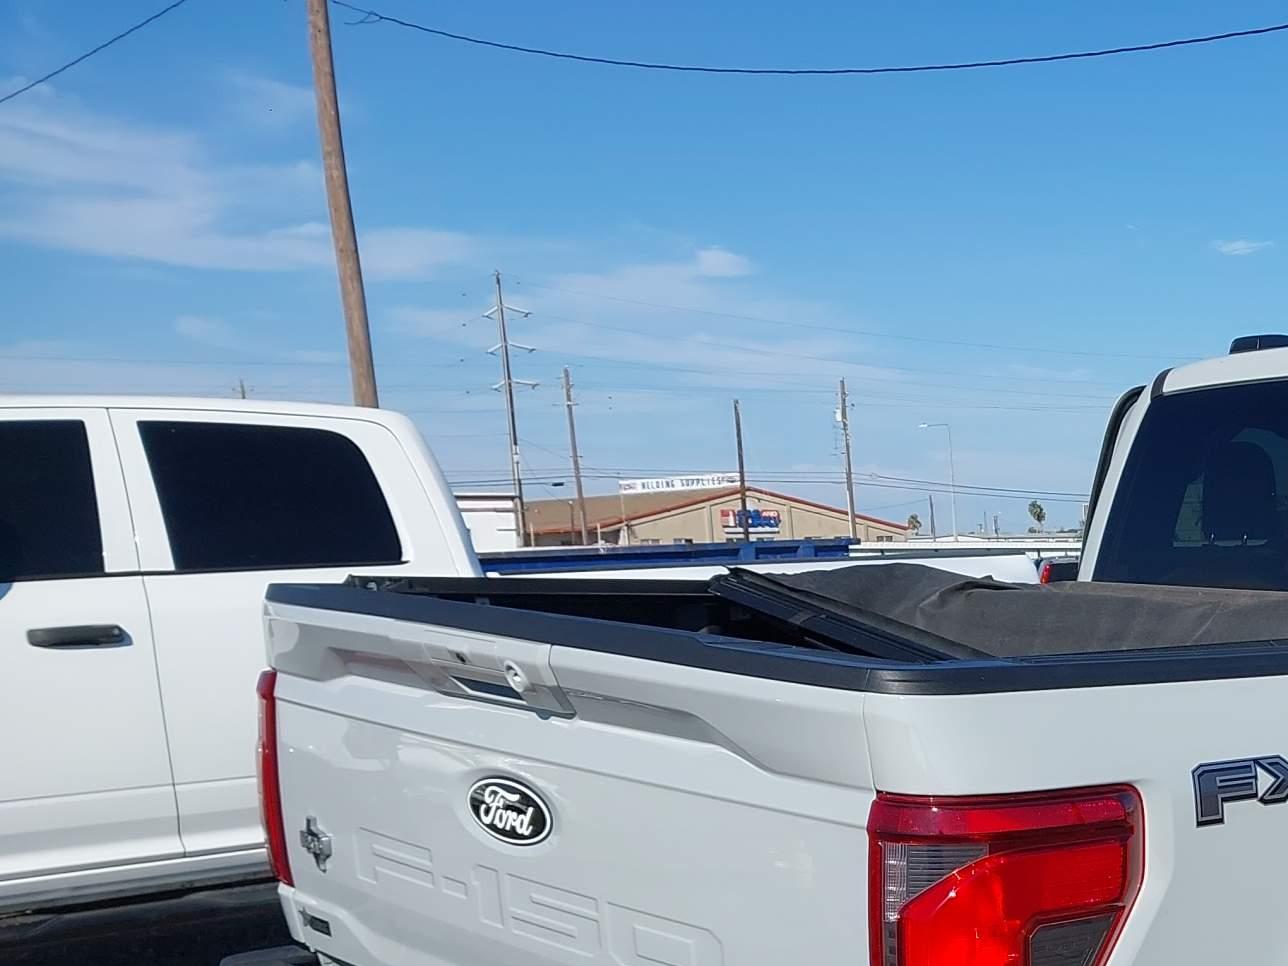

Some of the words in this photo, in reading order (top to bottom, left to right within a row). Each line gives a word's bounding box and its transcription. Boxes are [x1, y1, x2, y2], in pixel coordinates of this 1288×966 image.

[641, 480, 675, 489] WELDING
[680, 476, 721, 487] SUPPLIES
[480, 785, 532, 836] Ford
